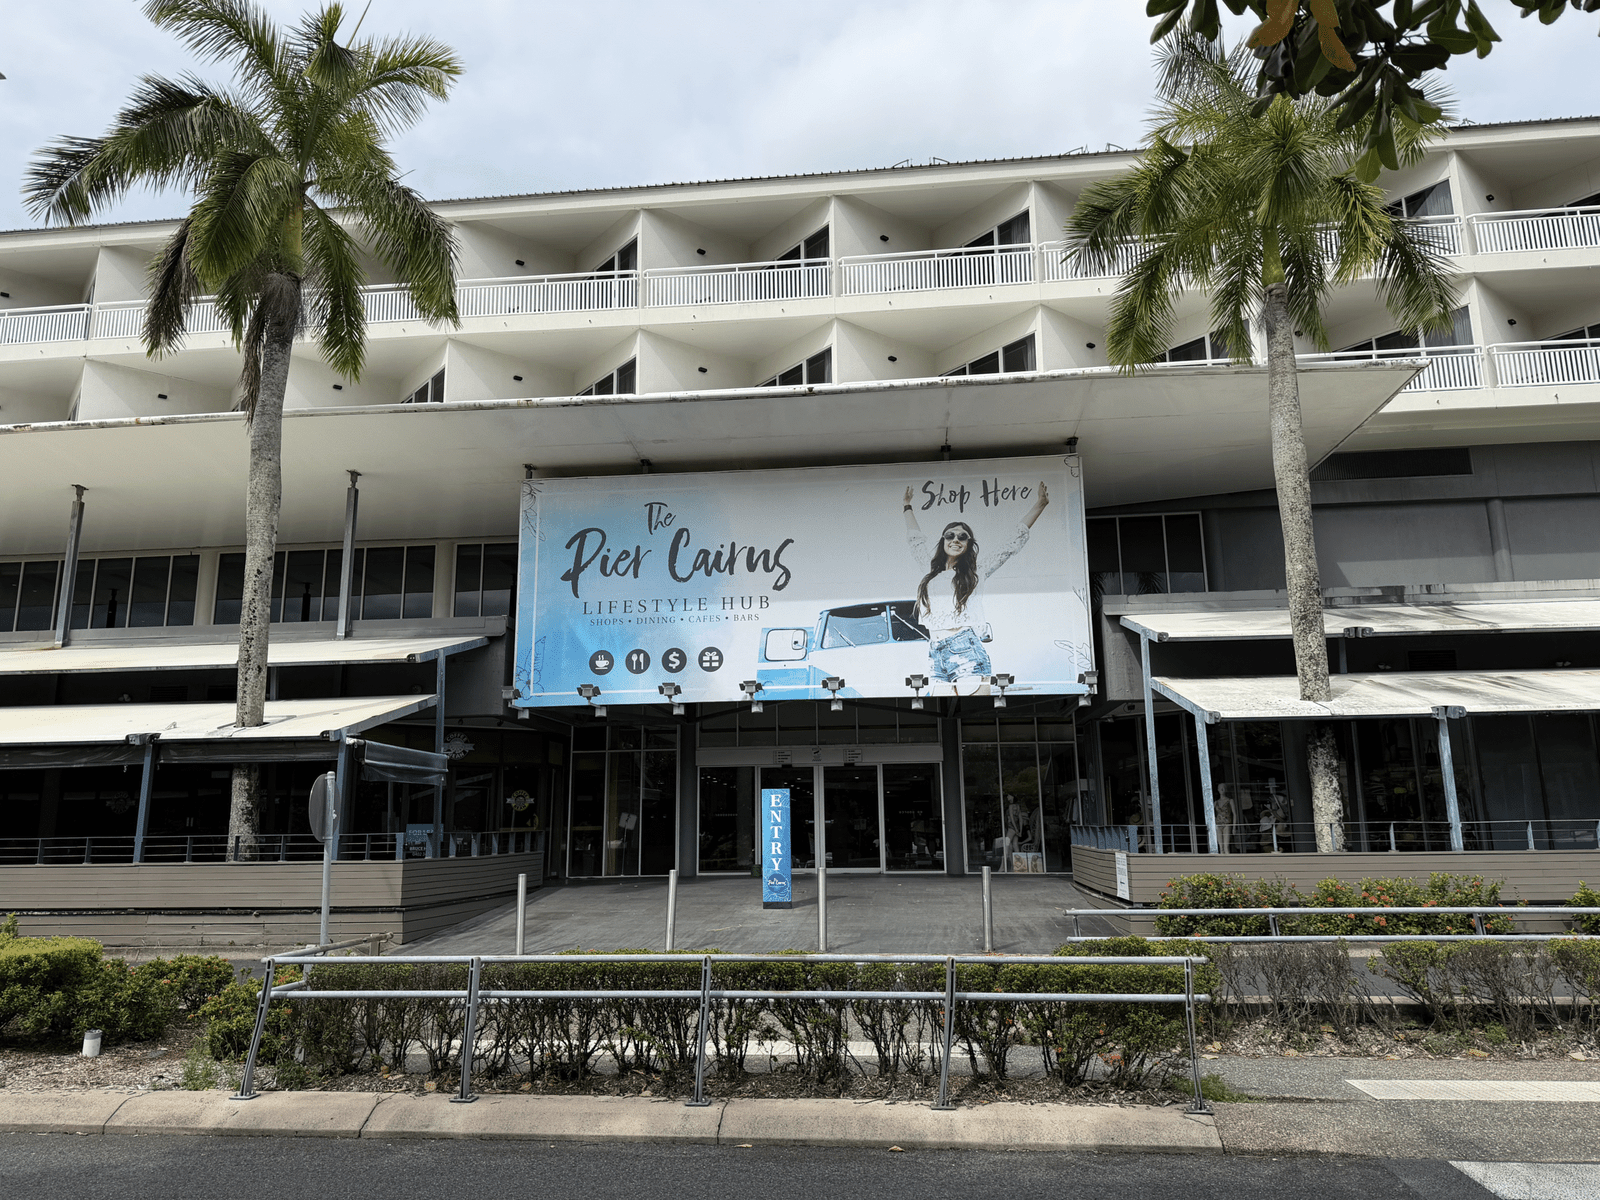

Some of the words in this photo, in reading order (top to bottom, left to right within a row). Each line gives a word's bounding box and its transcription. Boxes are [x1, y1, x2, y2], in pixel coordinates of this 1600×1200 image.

[921, 480, 970, 513] Shop
[980, 477, 1032, 507] Here
[644, 501, 676, 535] The
[560, 527, 652, 598] Pier
[668, 527, 794, 591] Cairns
[582, 597, 708, 615] LIFESTYLE
[721, 595, 770, 610] HUB
[590, 617, 624, 626] SHOPS
[636, 616, 676, 625] DINING
[688, 614, 721, 623] CAFES
[733, 613, 760, 622] BARS
[770, 794, 783, 871] ENTRY
